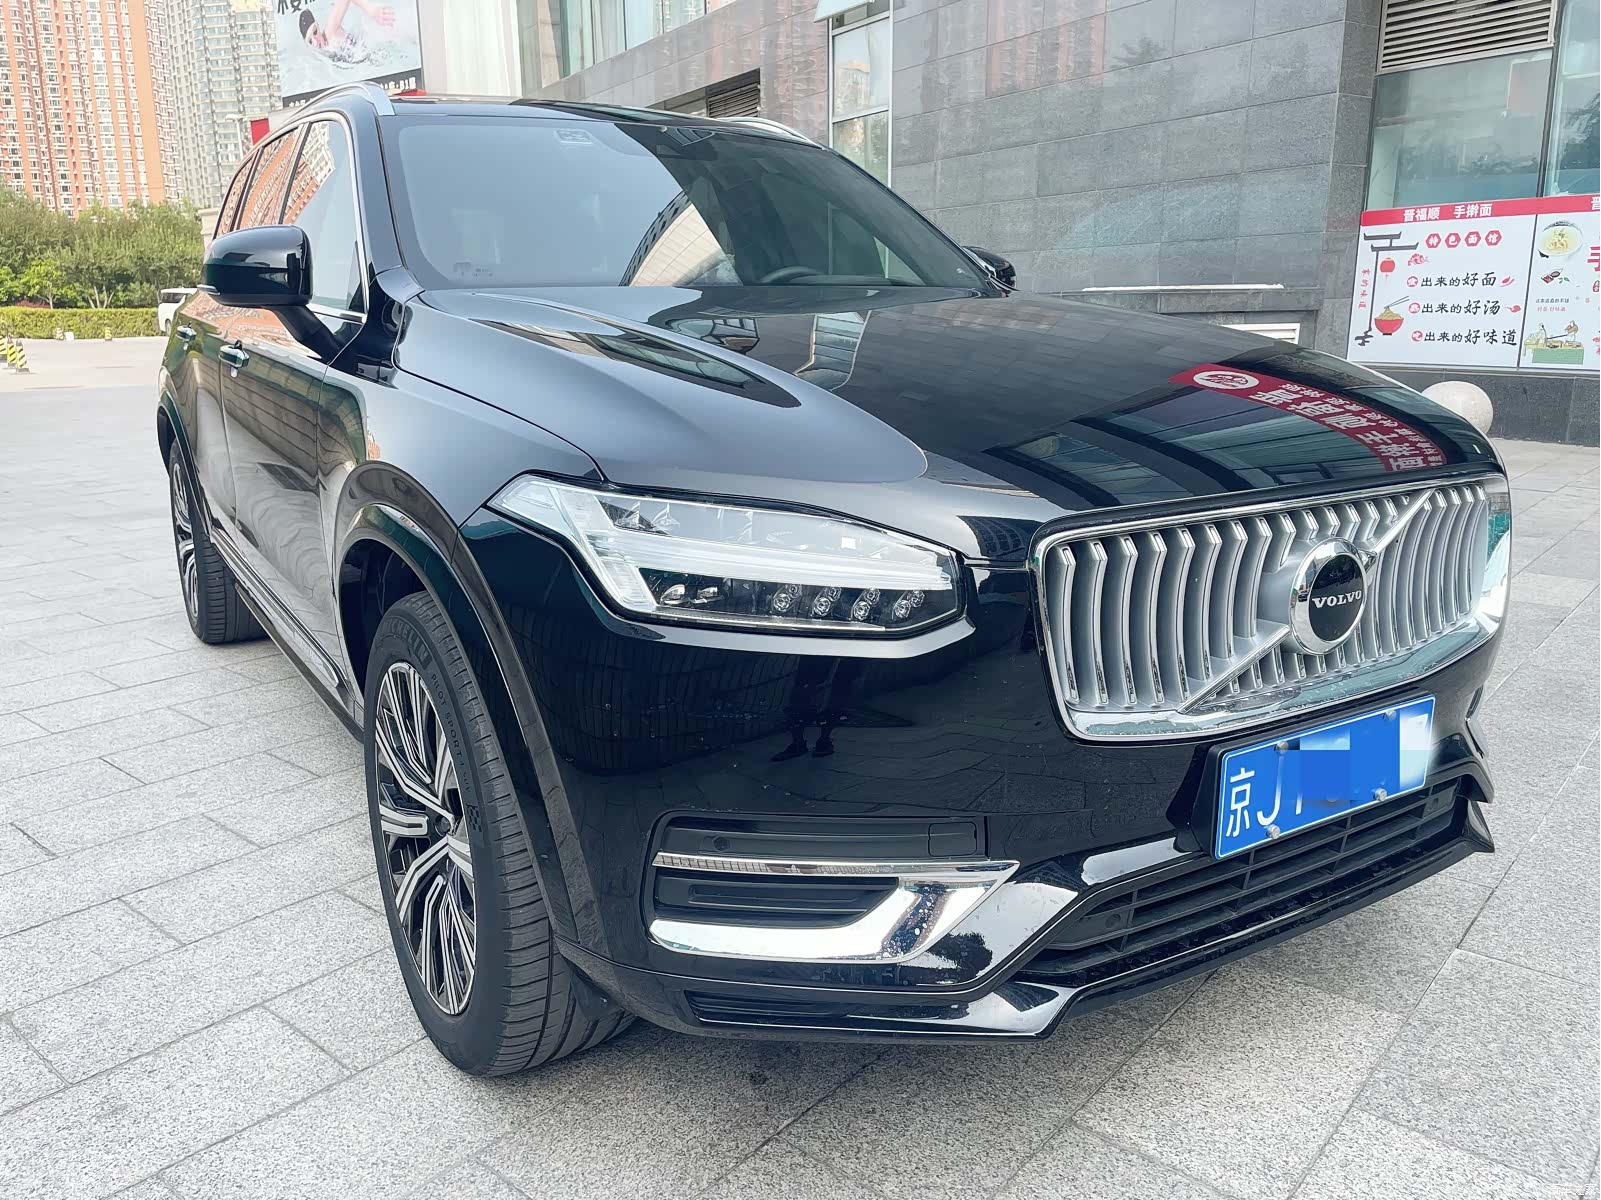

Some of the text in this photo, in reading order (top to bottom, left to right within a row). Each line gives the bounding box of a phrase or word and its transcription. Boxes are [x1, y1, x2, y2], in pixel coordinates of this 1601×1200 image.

[1403, 203, 1493, 223] 晋福顺 手擀面
[1312, 590, 1362, 609] VOLVO
[431, 674, 447, 706] PILOT
[446, 712, 463, 757] SPORT
